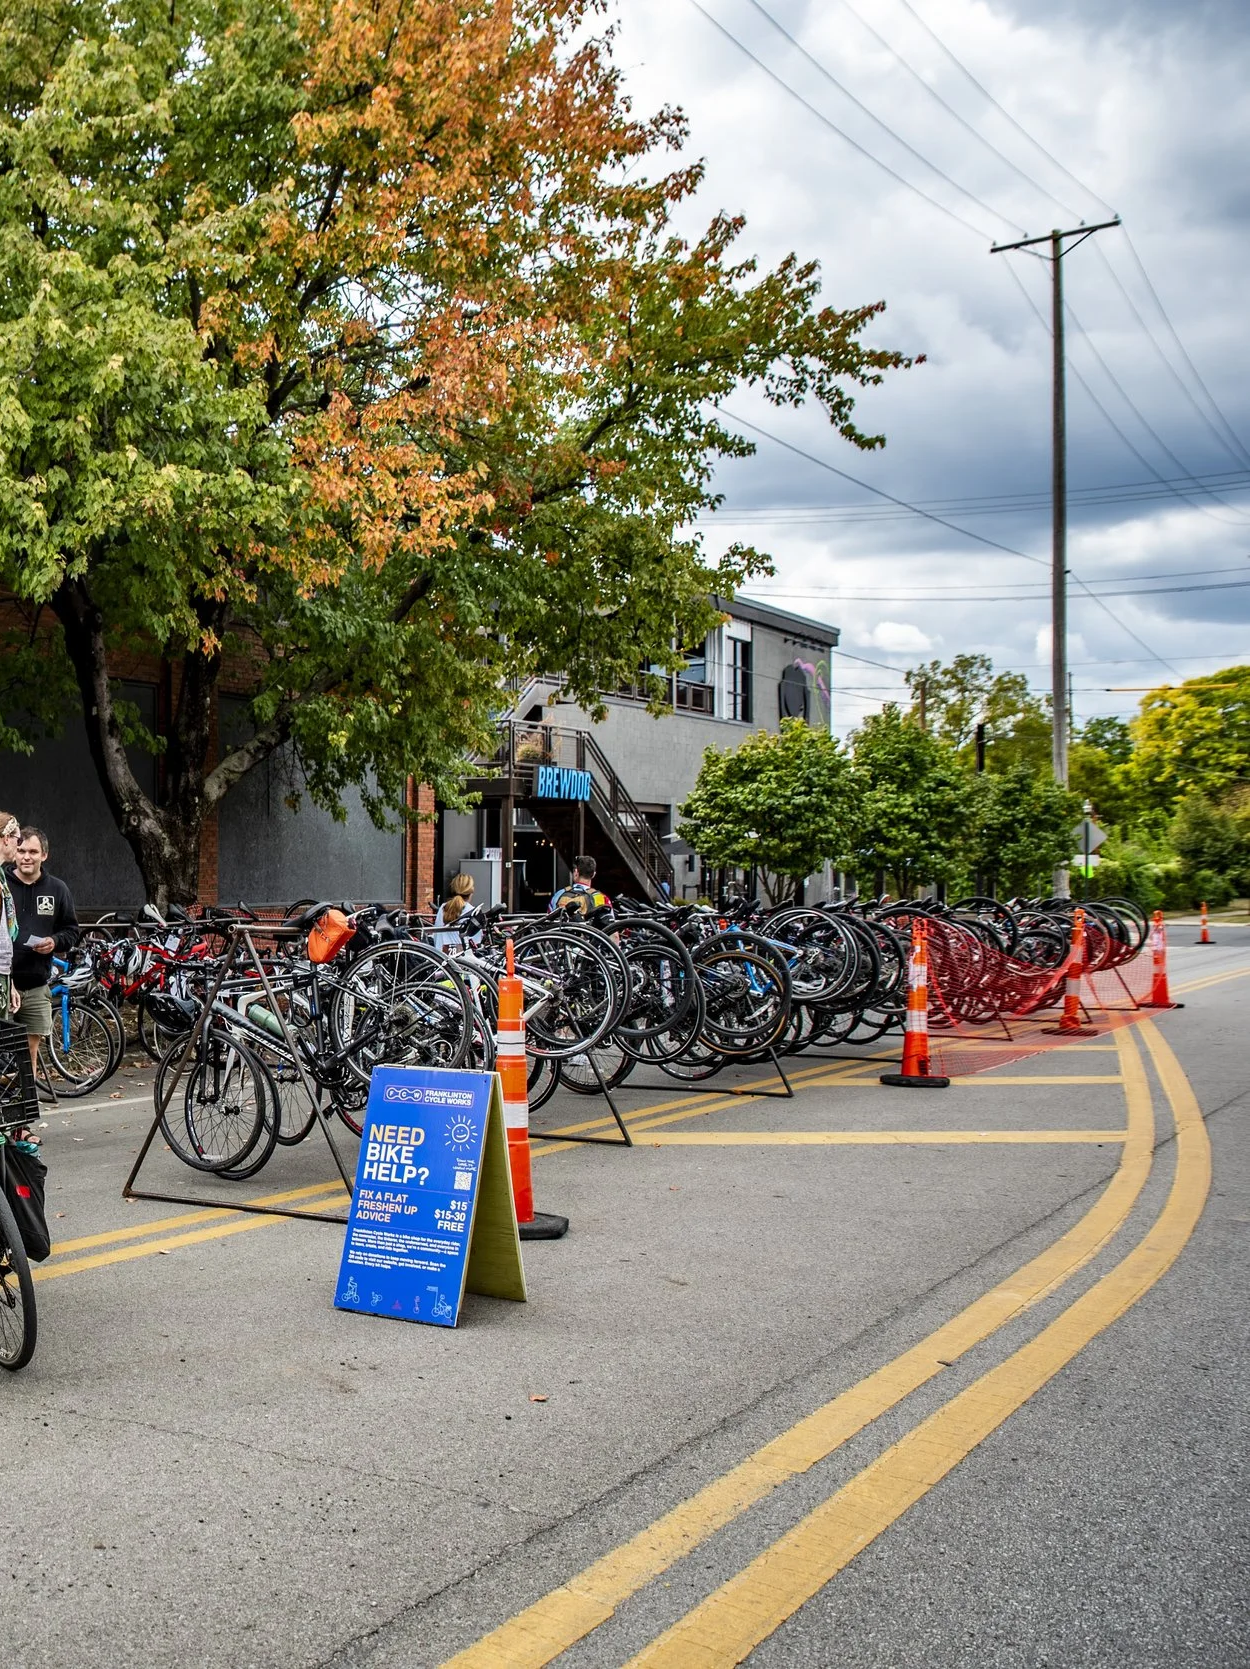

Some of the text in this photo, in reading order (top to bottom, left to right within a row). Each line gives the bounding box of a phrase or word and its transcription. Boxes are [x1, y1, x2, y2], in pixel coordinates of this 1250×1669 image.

[538, 767, 590, 800] BREWDOG
[425, 1090, 472, 1100] FRANKLINTON
[446, 1098, 472, 1106] WORKS
[369, 1124, 425, 1146] NEED
[366, 1142, 414, 1164] BIKE
[363, 1162, 429, 1186] HELP?
[358, 1200, 466, 1222] FRESHEN UP $15-30
[359, 1189, 468, 1211] FIX A FLAT $15
[356, 1210, 464, 1233] ADVICE FREE
